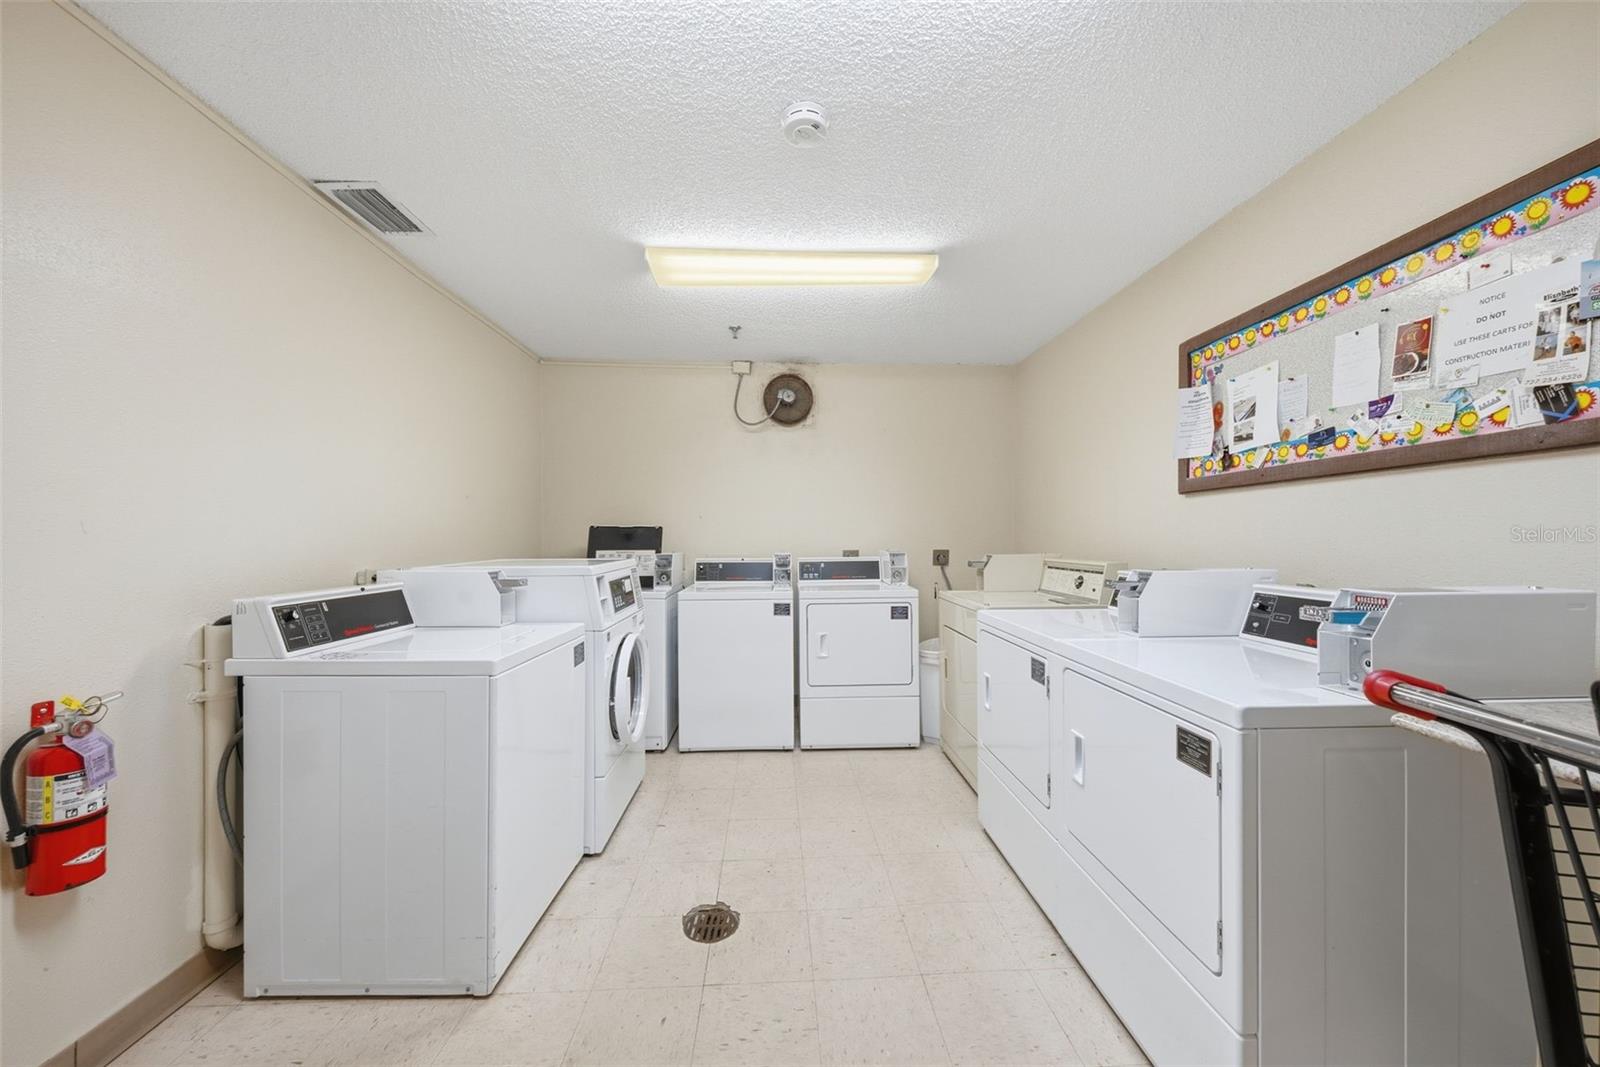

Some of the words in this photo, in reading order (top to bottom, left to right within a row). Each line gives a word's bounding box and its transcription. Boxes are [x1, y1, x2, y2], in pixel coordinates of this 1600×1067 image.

[1479, 292, 1506, 305] NOTICE
[1476, 315, 1488, 324] DO
[1489, 310, 1507, 320] NOT
[1454, 338, 1467, 347] USE
[1469, 332, 1491, 343] THESE
[1492, 325, 1517, 337] CARTS
[1444, 348, 1498, 366] CONSTRUCTION
[1499, 340, 1531, 353] MATERI
